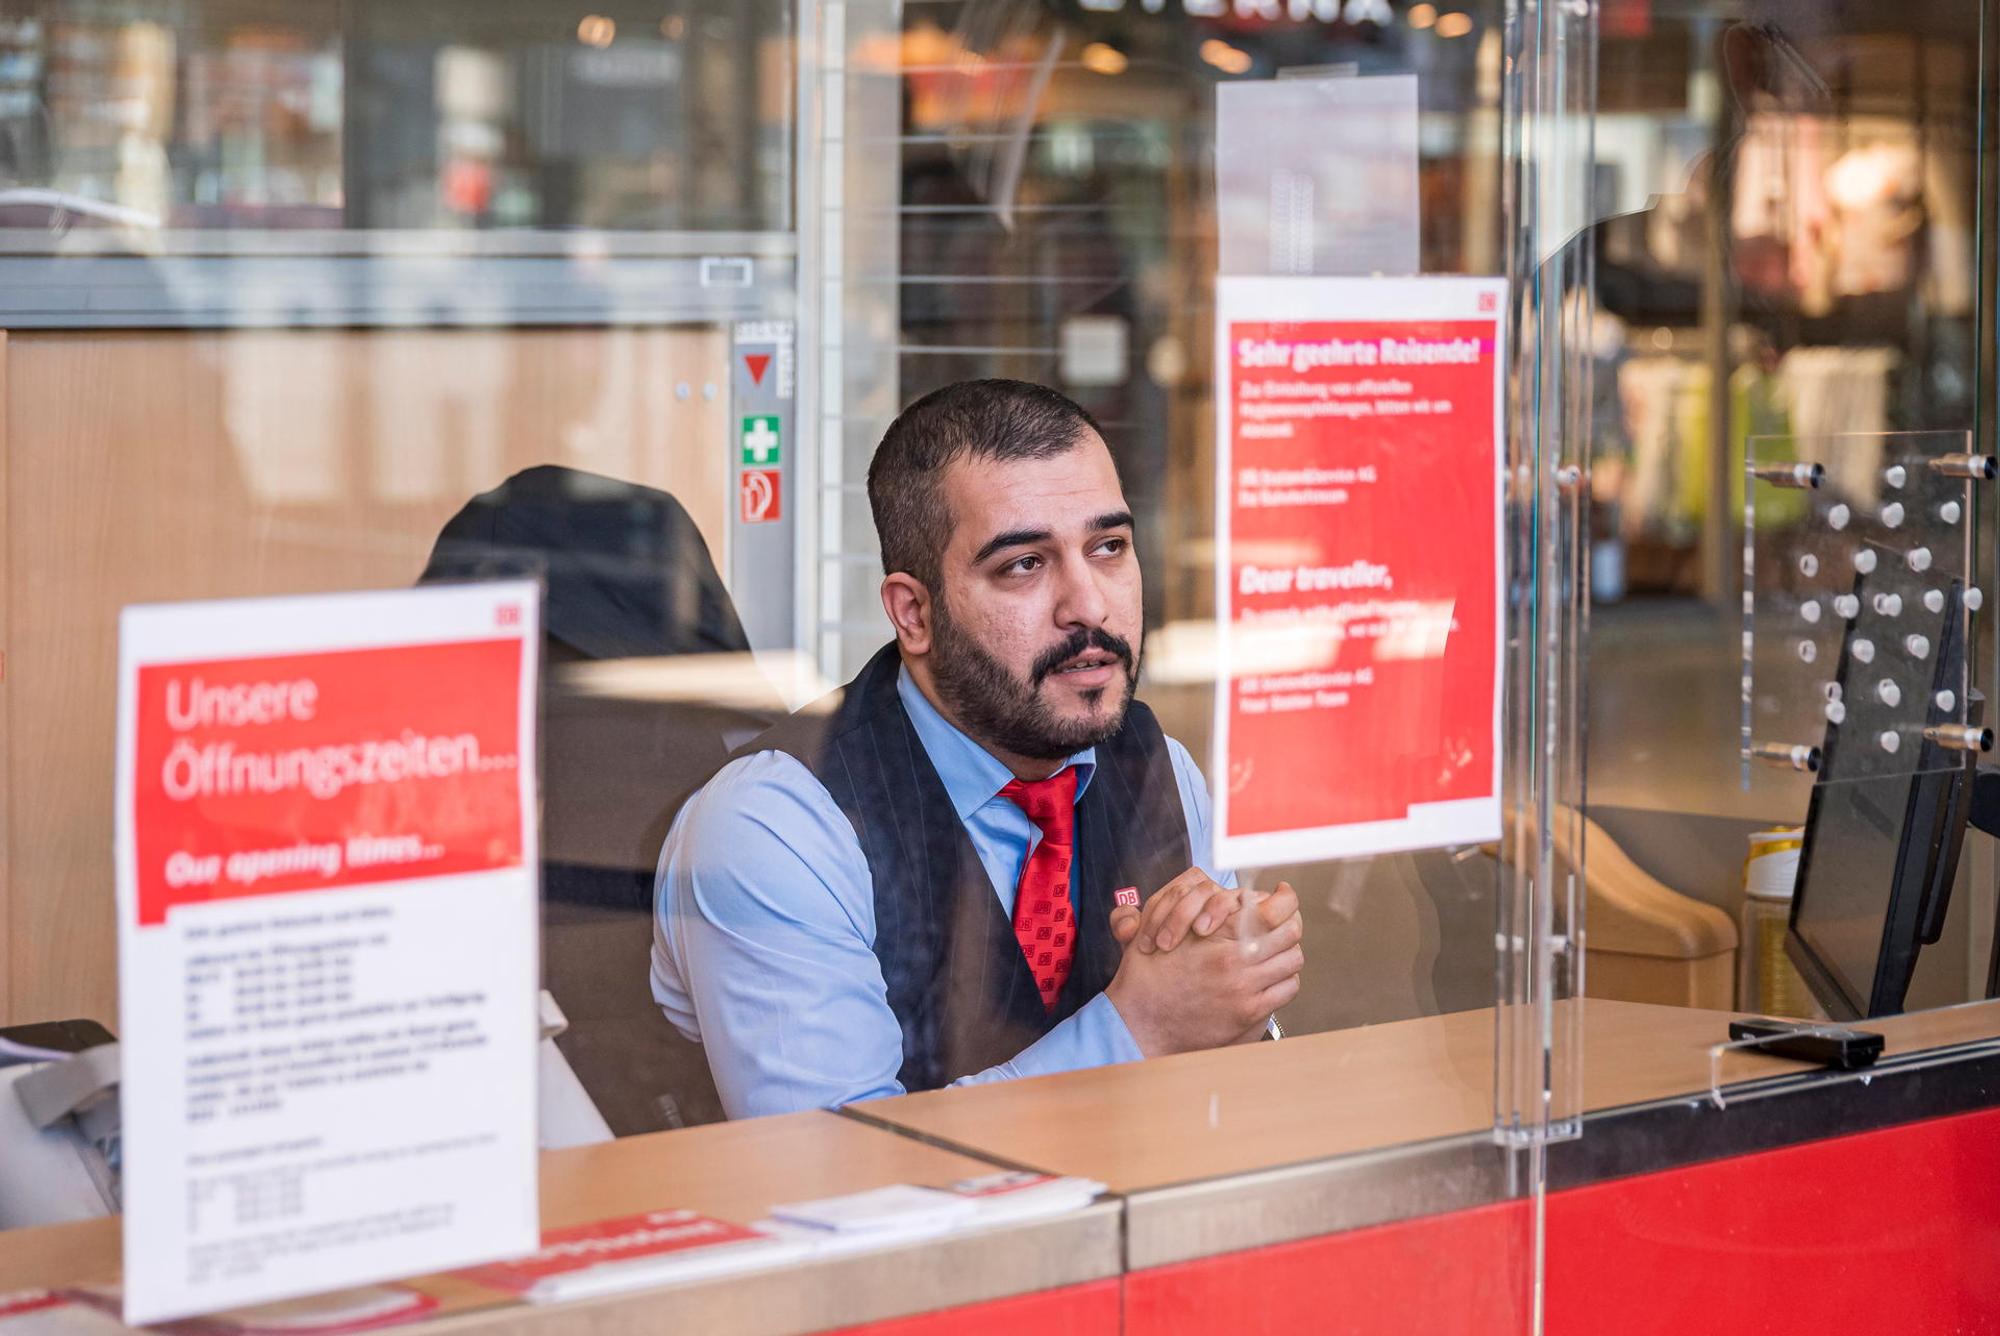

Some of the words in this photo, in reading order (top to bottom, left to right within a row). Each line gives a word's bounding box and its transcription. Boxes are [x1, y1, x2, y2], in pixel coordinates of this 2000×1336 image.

[1239, 339, 1290, 366] Sehr
[1292, 338, 1377, 372] geehrte
[1379, 337, 1480, 363] Reisende!
[1239, 565, 1293, 594] Dear
[1295, 560, 1393, 591] traveller,
[166, 678, 318, 730] Unsere
[162, 729, 517, 800] Öffnungszeiten...
[165, 852, 220, 887] Our
[226, 842, 340, 883] opening
[346, 835, 445, 867] times...
[1118, 890, 1138, 906] DB
